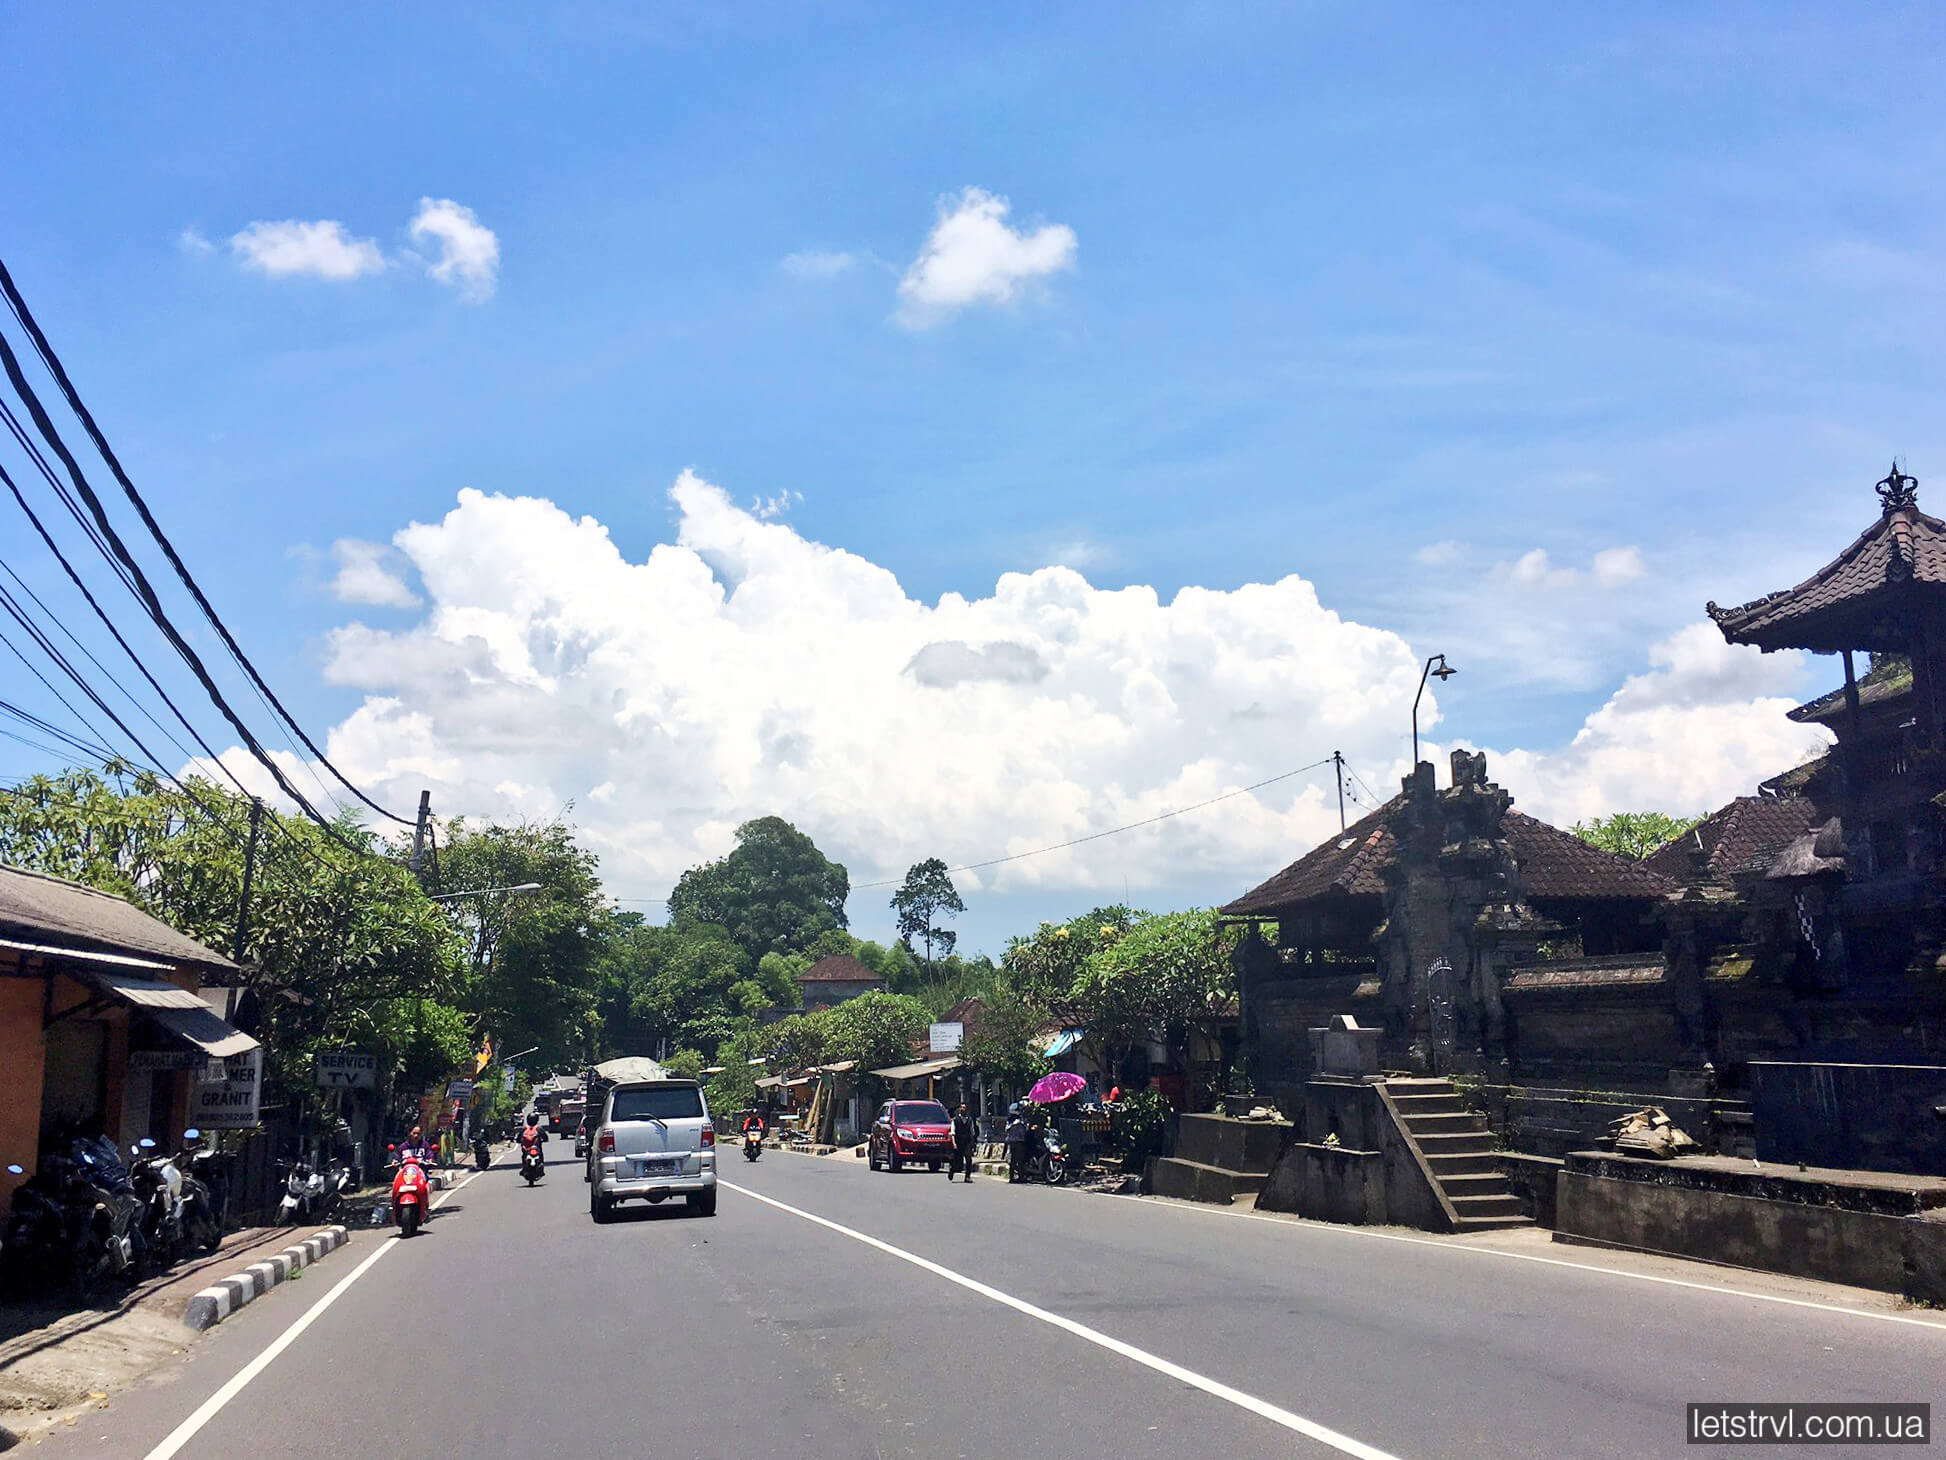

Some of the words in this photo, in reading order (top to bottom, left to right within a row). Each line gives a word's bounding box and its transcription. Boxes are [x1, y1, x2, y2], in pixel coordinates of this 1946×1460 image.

[321, 1056, 373, 1068] SERVICE
[328, 1072, 359, 1083] TV
[201, 1092, 251, 1106] GRANIT
